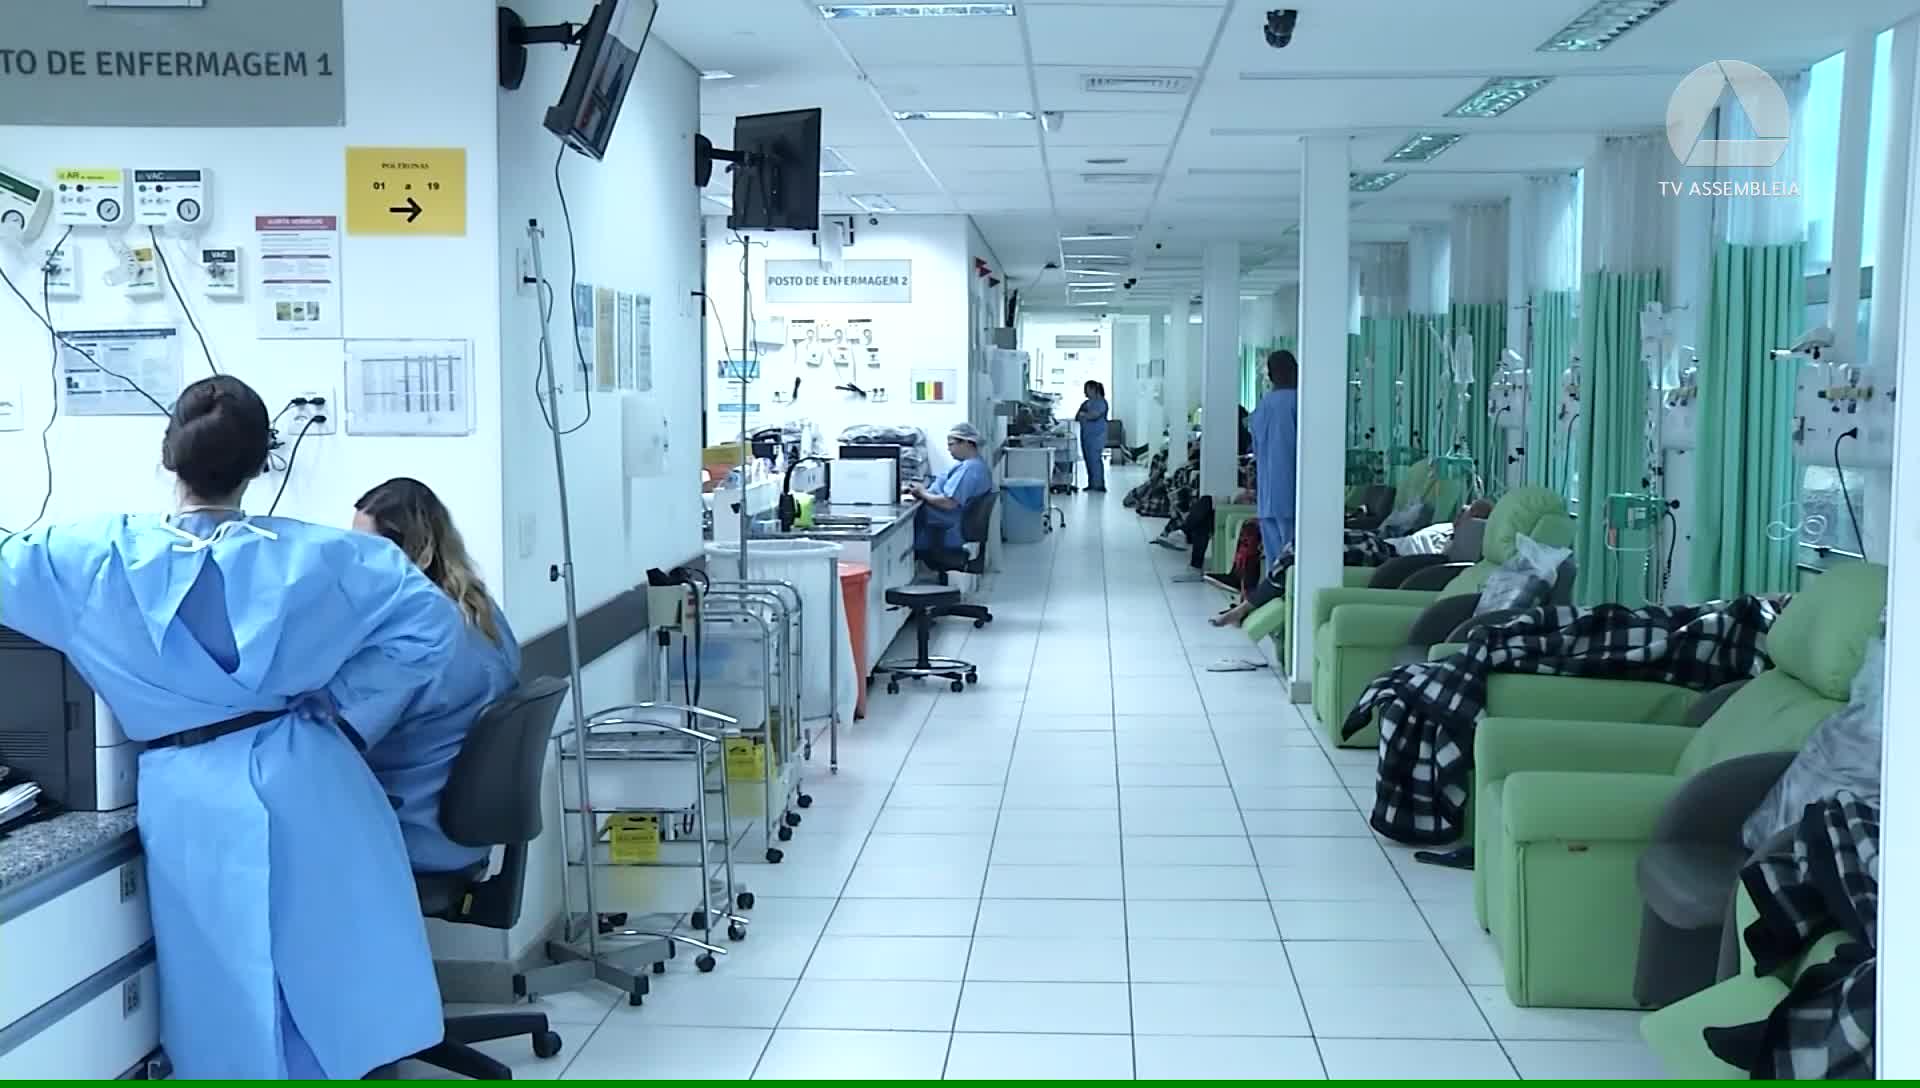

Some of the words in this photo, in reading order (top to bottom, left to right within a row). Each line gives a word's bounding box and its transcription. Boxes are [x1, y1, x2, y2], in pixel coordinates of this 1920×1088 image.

[0, 49, 37, 75] TO
[47, 50, 87, 76] DE
[96, 51, 308, 77] ENFERMAGEM
[316, 52, 333, 76] 1
[373, 182, 385, 190] 01
[428, 182, 440, 190] 19
[768, 276, 803, 286] POSTO
[805, 276, 820, 286] DE
[823, 276, 899, 286] ENFERMAGEM
[901, 276, 908, 286] 2
